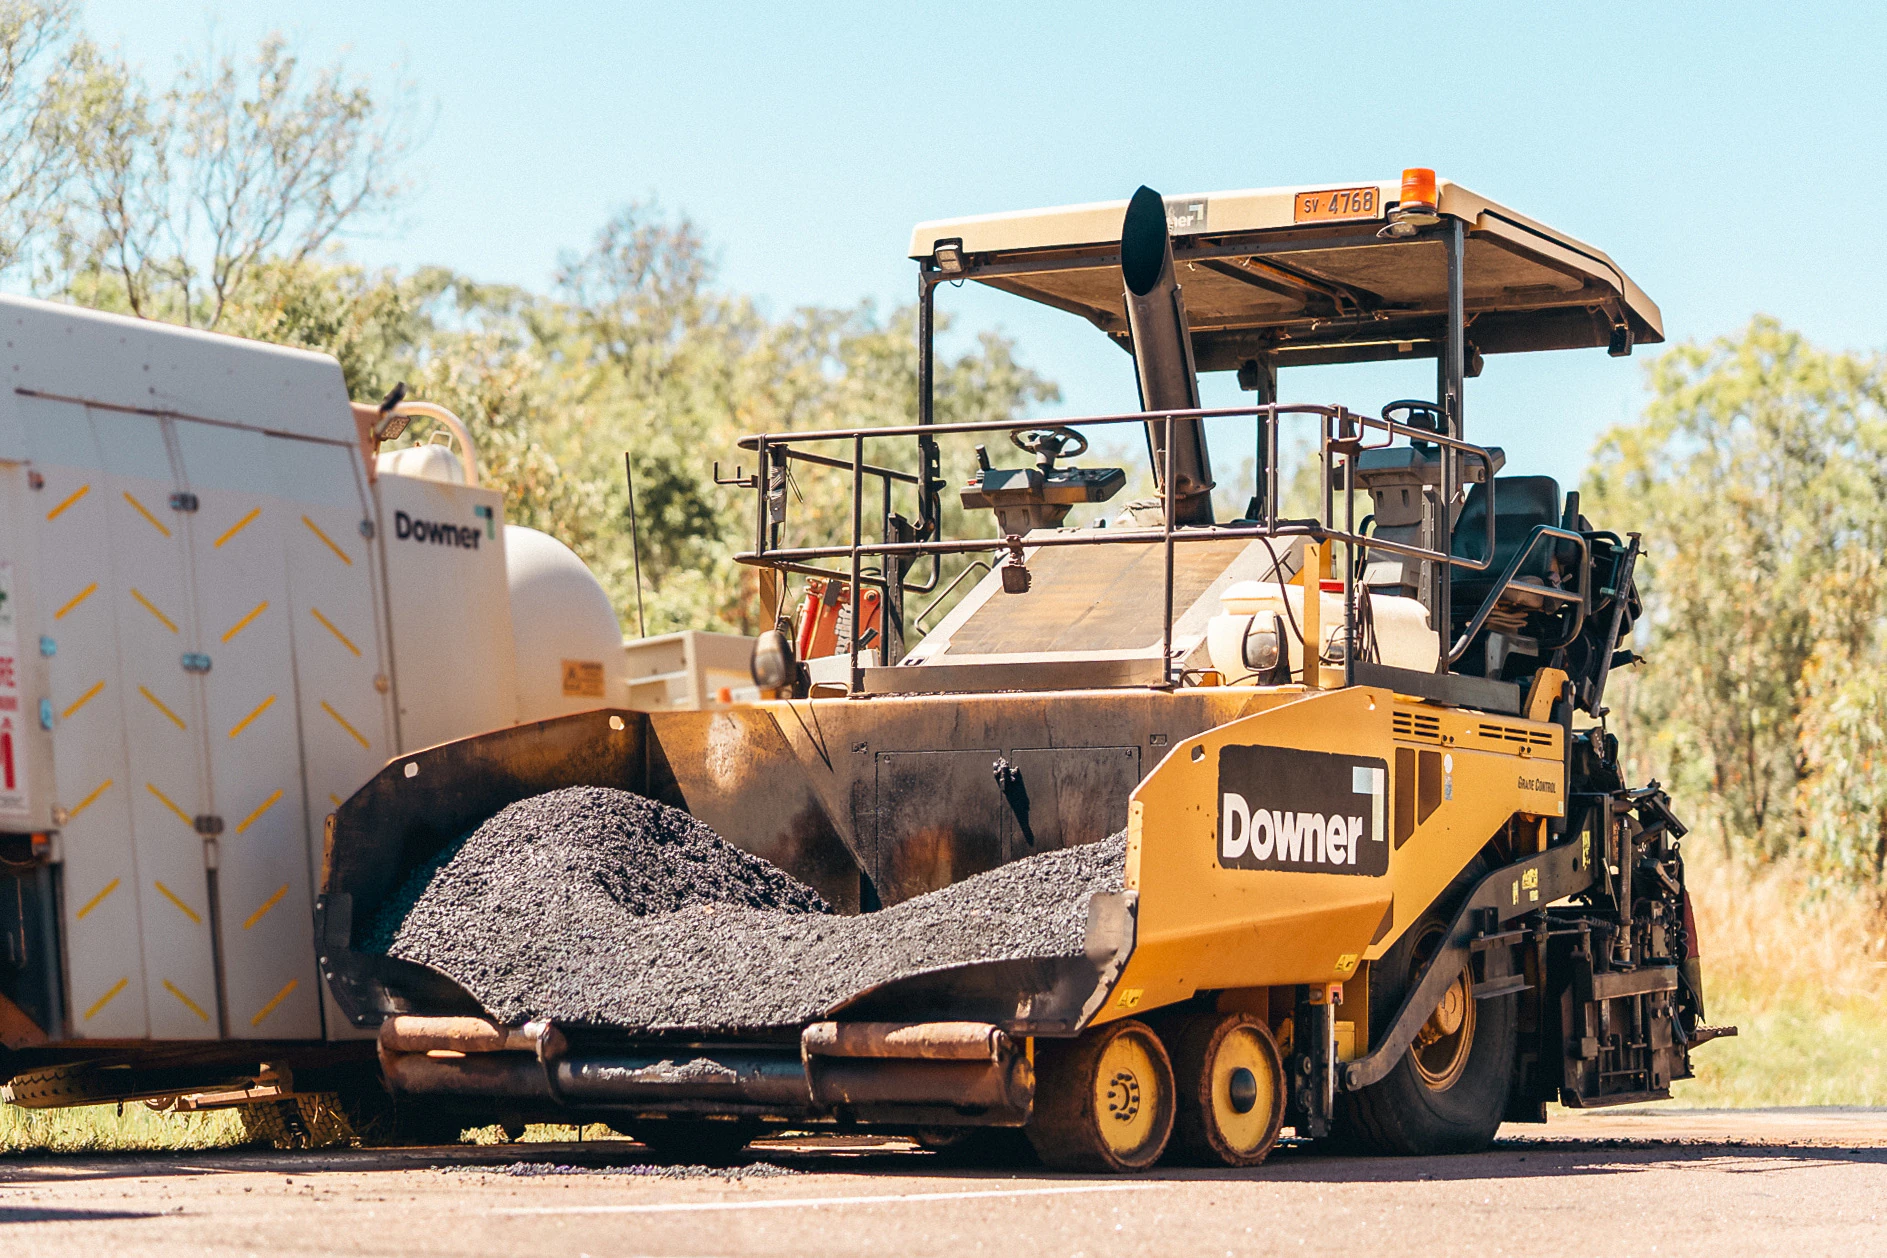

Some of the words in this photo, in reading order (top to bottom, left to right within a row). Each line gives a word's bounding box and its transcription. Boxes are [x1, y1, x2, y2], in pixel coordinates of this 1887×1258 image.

[1304, 197, 1319, 213] SV
[1328, 190, 1373, 214] 4768
[1166, 215, 1194, 228] ner
[395, 510, 481, 549] Downer
[1223, 793, 1363, 865] Downer
